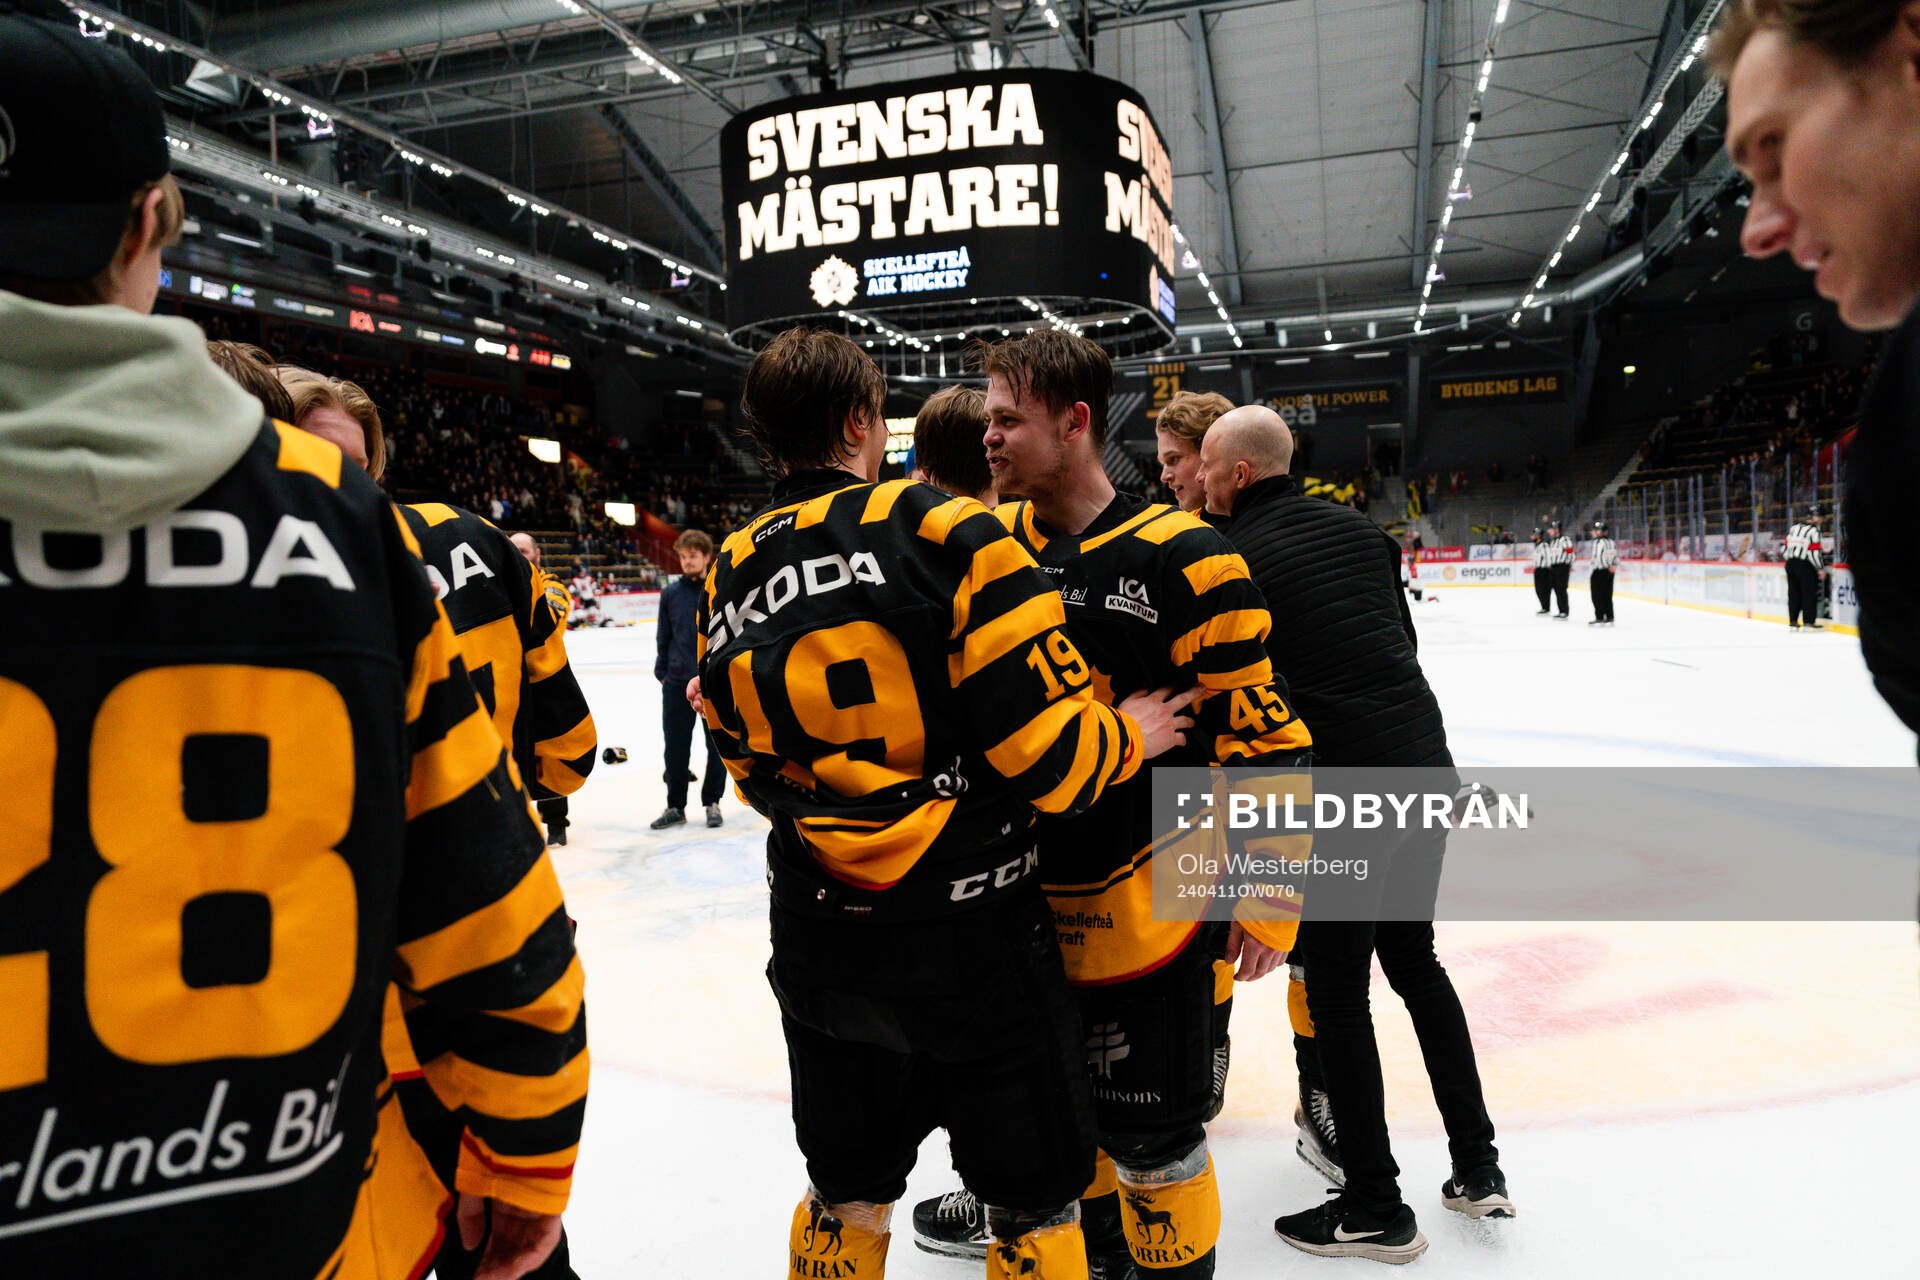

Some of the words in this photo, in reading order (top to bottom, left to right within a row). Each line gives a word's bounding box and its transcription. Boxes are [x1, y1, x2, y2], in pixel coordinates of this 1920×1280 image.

[747, 83, 1044, 181] SVENSKA
[738, 163, 1060, 261] MÄSTARE!
[866, 276, 898, 296] AIK
[900, 268, 969, 293] HOCKEY
[1332, 389, 1390, 407] POWER
[1441, 380, 1519, 399] BYGDENS
[1523, 377, 1557, 393] LAG
[755, 515, 794, 543] CCM
[0, 511, 357, 592] ODA
[1119, 576, 1150, 605] ICA
[1461, 567, 1511, 580] engcon
[1069, 587, 1088, 602] Bil
[1107, 597, 1157, 621] KVANTUM
[1026, 630, 1091, 702] 19
[728, 620, 926, 798] 19
[1229, 681, 1291, 734] 45
[0, 662, 360, 1091] 8
[949, 844, 1039, 901] CCM
[1057, 930, 1085, 946] raft
[266, 1053, 352, 1162] Bil
